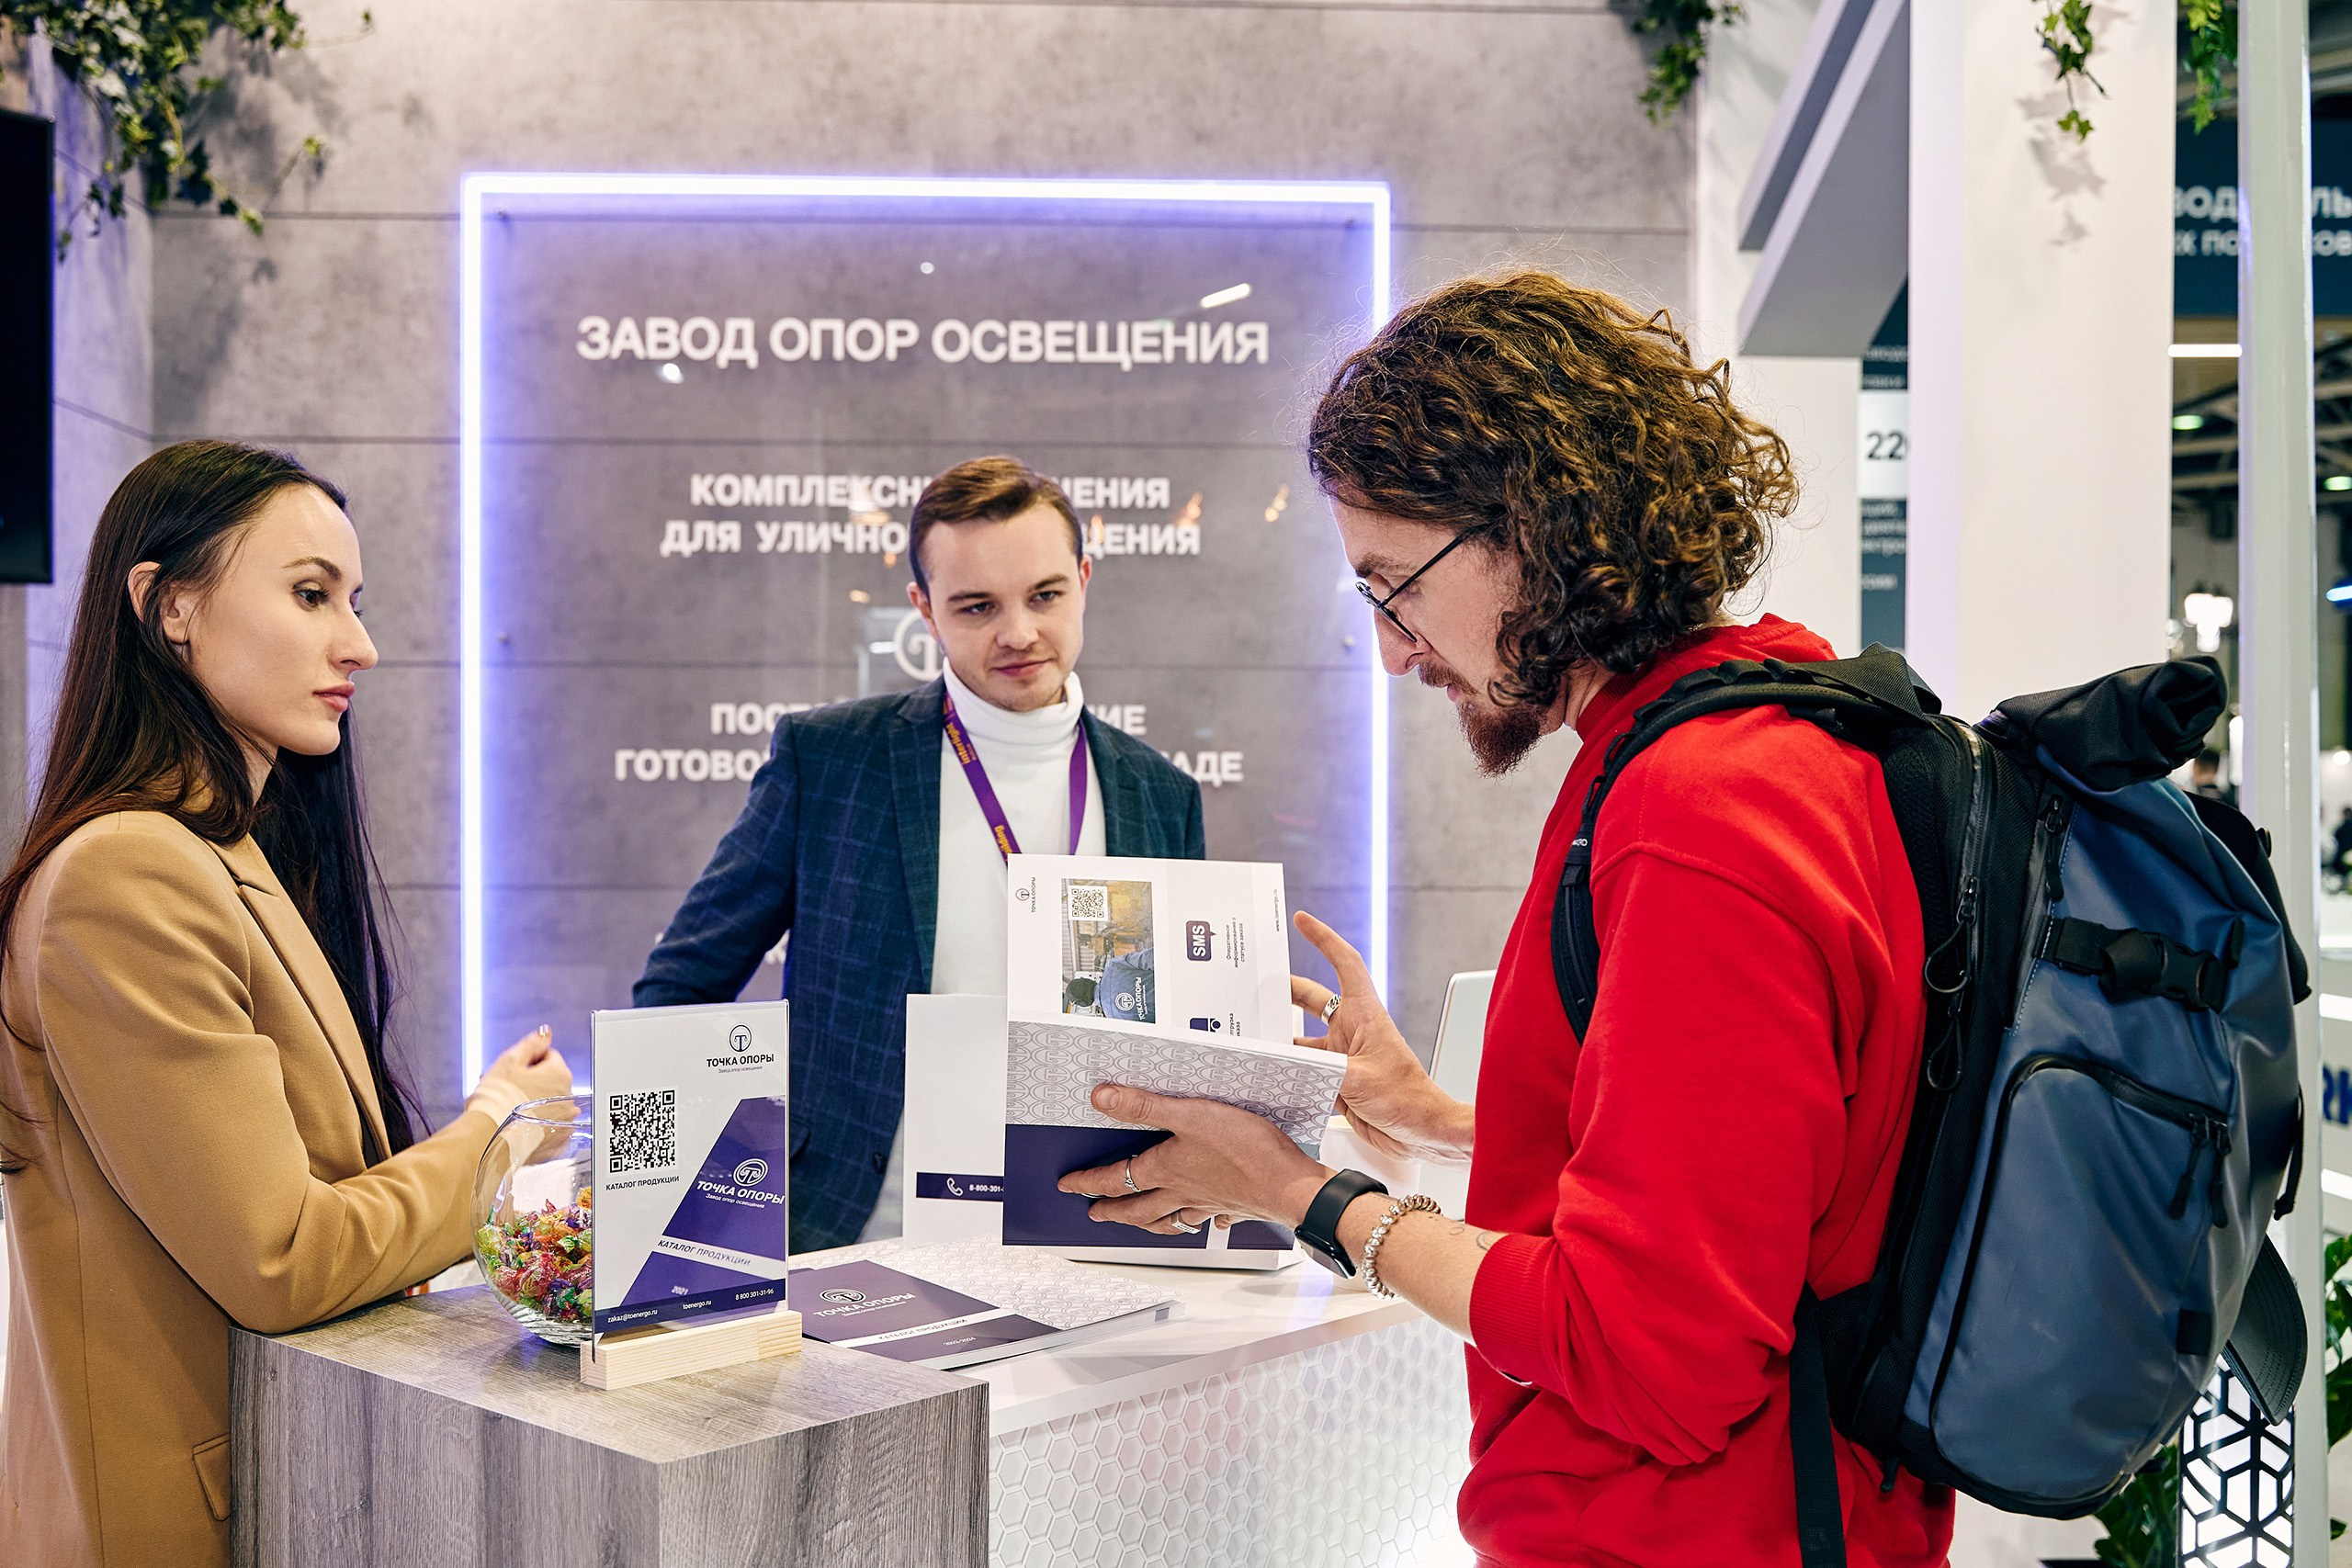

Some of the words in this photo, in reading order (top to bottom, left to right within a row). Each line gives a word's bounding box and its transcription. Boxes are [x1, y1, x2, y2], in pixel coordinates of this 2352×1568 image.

[575, 315, 758, 369] ЗАВОД
[769, 318, 919, 362] ОПОР
[931, 319, 1270, 370] ОСВЕЩЕНИЯ
[1867, 430, 1906, 460] 22
[690, 473, 935, 507] КОМПЛЕКСН
[1053, 476, 1170, 509] ЕНИЯ
[660, 520, 741, 558] ДЛЯ
[754, 521, 910, 554] УЛИЧНО
[615, 748, 772, 782] ГОТОВО
[1193, 925, 1206, 957] SMS
[707, 1056, 738, 1067] ТОЧКА
[740, 1054, 774, 1065] ОПОРЫ
[606, 1180, 637, 1190] КАТАЛОГ
[638, 1176, 680, 1187] ПРОДУКЦИИ
[696, 1180, 735, 1196] ТОЧКА
[737, 1188, 785, 1204] ОПОРЫ
[969, 1184, 1004, 1192] 8-800-301-
[657, 1239, 695, 1253] КАТАЛОГ
[696, 1247, 751, 1266] ПРОДУКЦИИ
[607, 1309, 658, 1324] zakaz@toenergo.ru
[683, 1300, 711, 1310] toenergo.ru
[813, 1303, 865, 1317] ТОЧКА
[863, 1292, 917, 1306] ОПОРЫ
